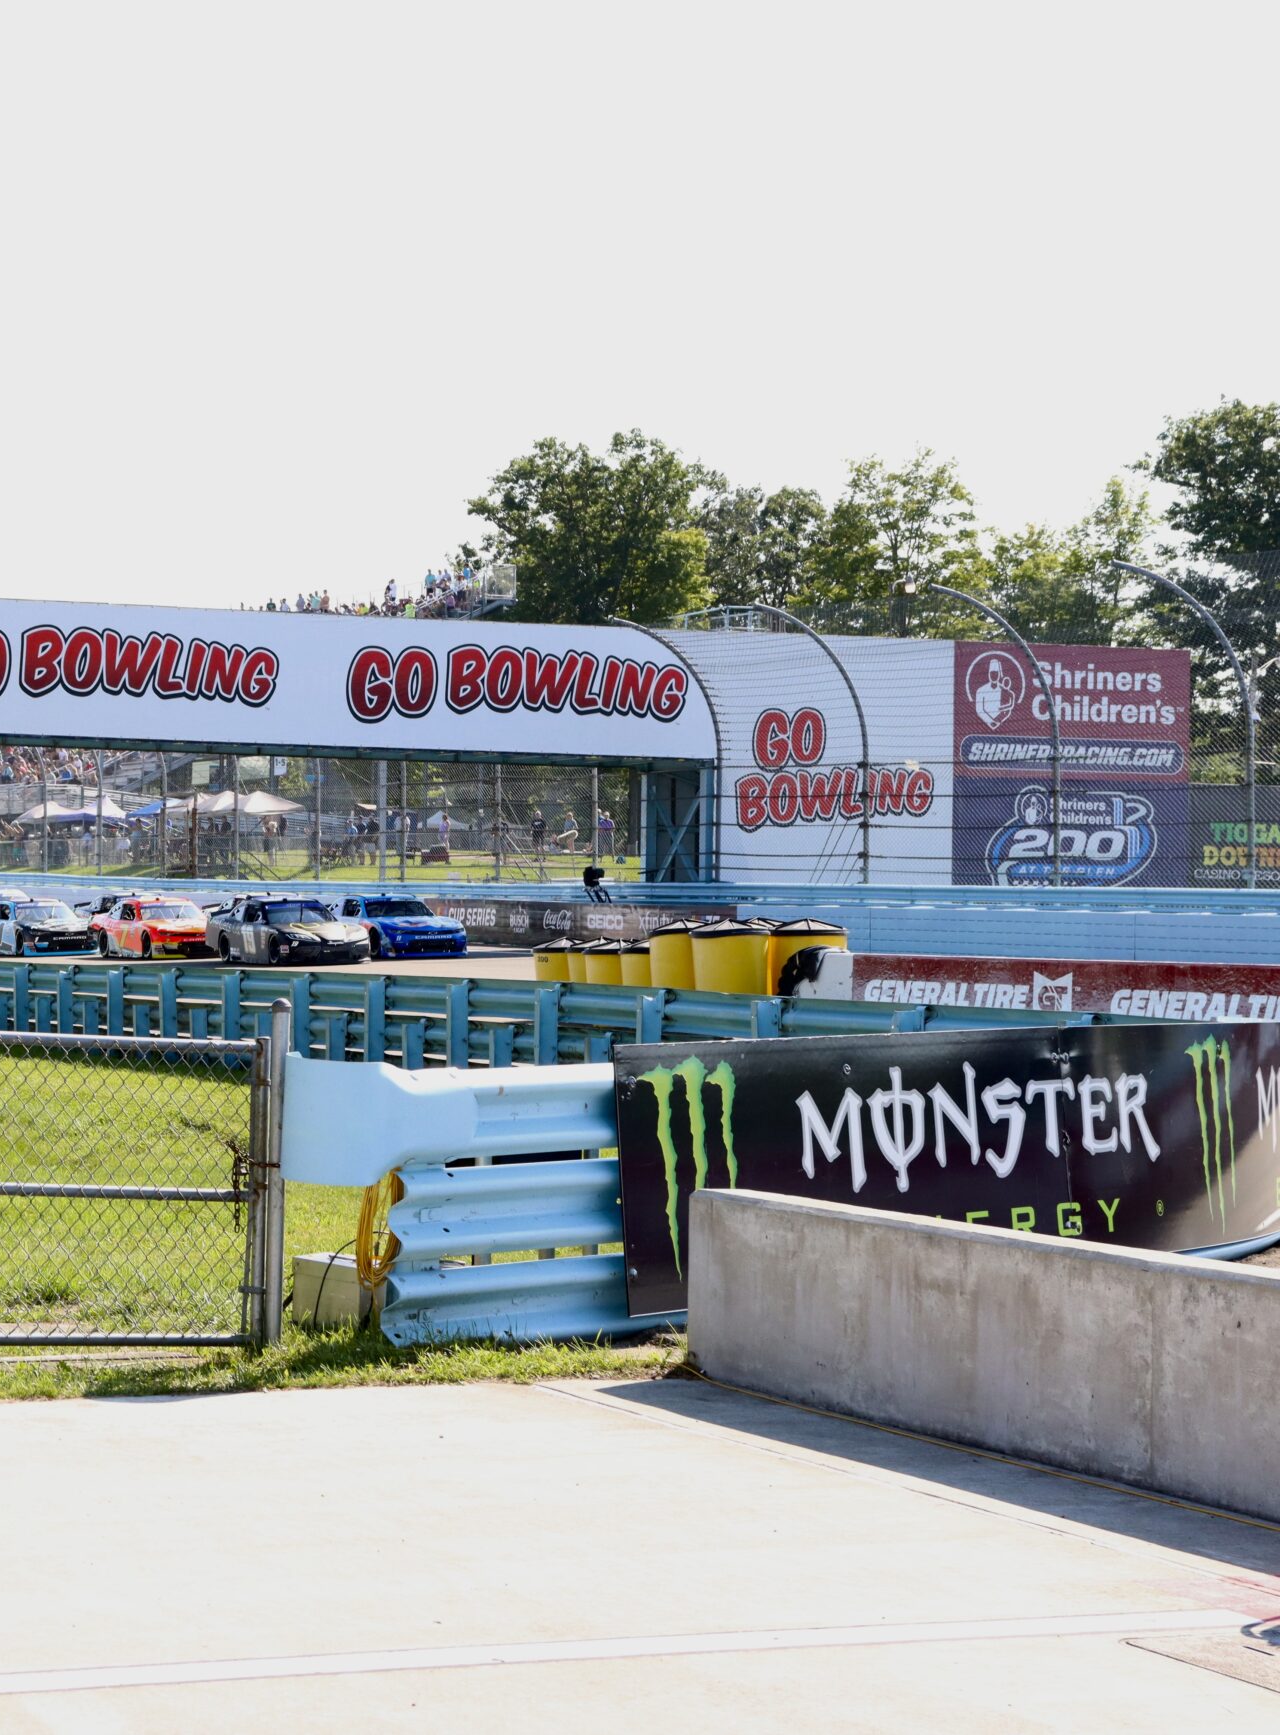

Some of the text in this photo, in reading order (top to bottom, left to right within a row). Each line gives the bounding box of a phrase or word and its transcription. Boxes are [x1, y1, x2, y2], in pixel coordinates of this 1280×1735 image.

[20, 624, 279, 707] BOWLING
[1032, 661, 1162, 692] Shriners
[346, 643, 688, 724] GO BOWLING
[752, 707, 826, 773] GO
[735, 767, 934, 833] BOWLING
[1008, 828, 1125, 861] 200
[448, 907, 497, 927] CUP SERIES
[509, 913, 529, 927] BUSCH
[587, 914, 624, 930] GEICO
[864, 979, 970, 1007] GENERAL
[970, 983, 1031, 1010] TIRE
[1110, 989, 1246, 1021] GENERAL
[796, 1061, 1161, 1194] MONSTER
